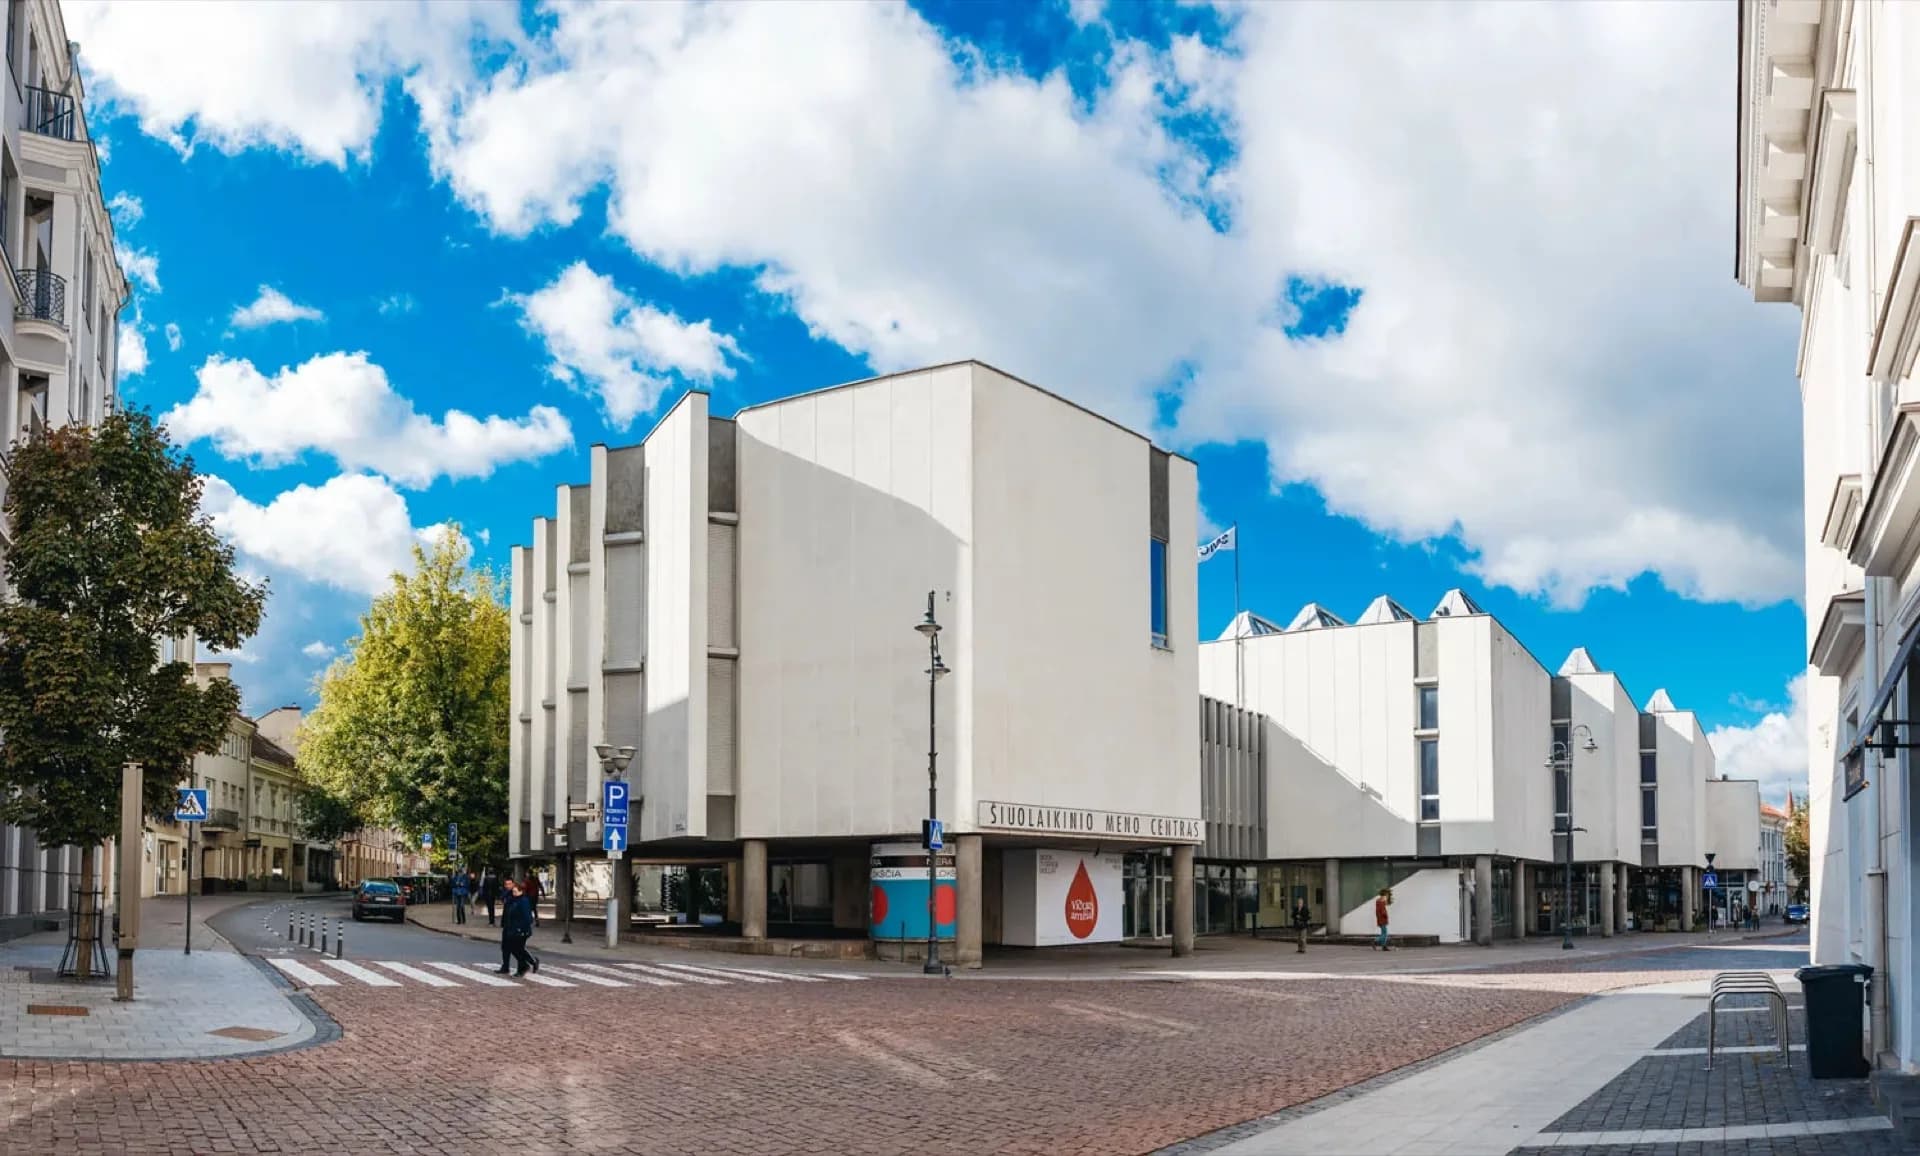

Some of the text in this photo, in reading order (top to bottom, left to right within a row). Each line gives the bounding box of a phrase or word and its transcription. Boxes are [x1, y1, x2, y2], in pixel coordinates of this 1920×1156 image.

[609, 785, 624, 808] P
[990, 804, 1200, 838] ŠIUOLAIKINIO MENO CENTRAS
